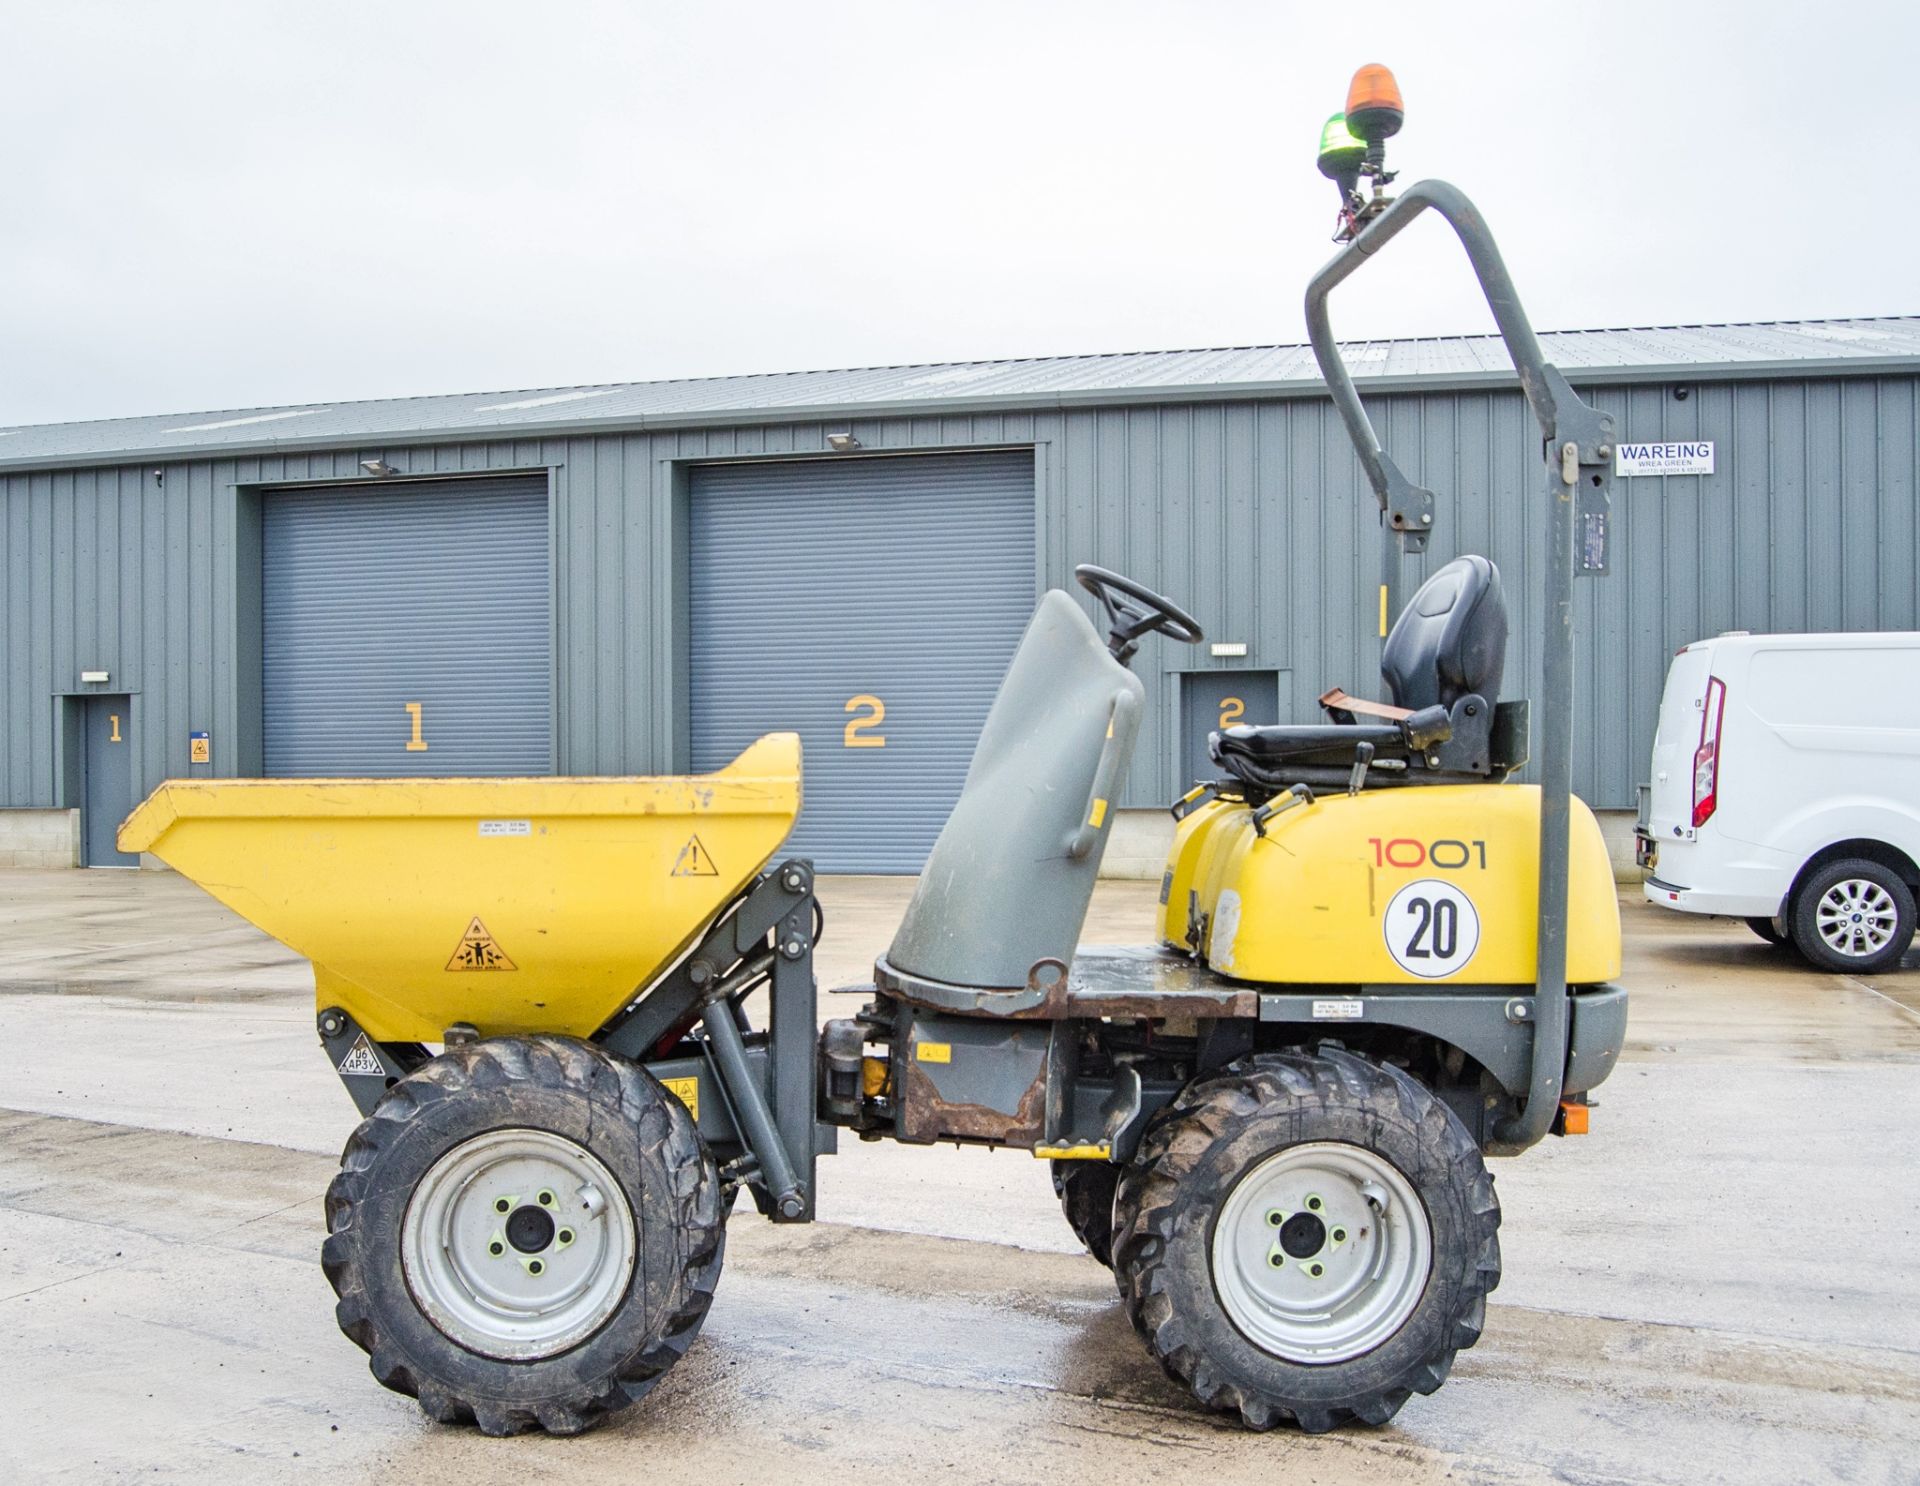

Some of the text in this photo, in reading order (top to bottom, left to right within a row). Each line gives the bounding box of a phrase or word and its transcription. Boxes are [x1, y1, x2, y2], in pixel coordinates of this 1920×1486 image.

[1621, 444, 1710, 459] WAREING
[1665, 459, 1692, 467] GREEN
[110, 715, 121, 742] 1
[406, 703, 428, 751] 1
[844, 695, 885, 747] 2
[1220, 697, 1245, 729] 2
[1368, 838, 1486, 869] 1001
[1406, 897, 1457, 959] 20
[349, 1059, 375, 1070] AP3Y
